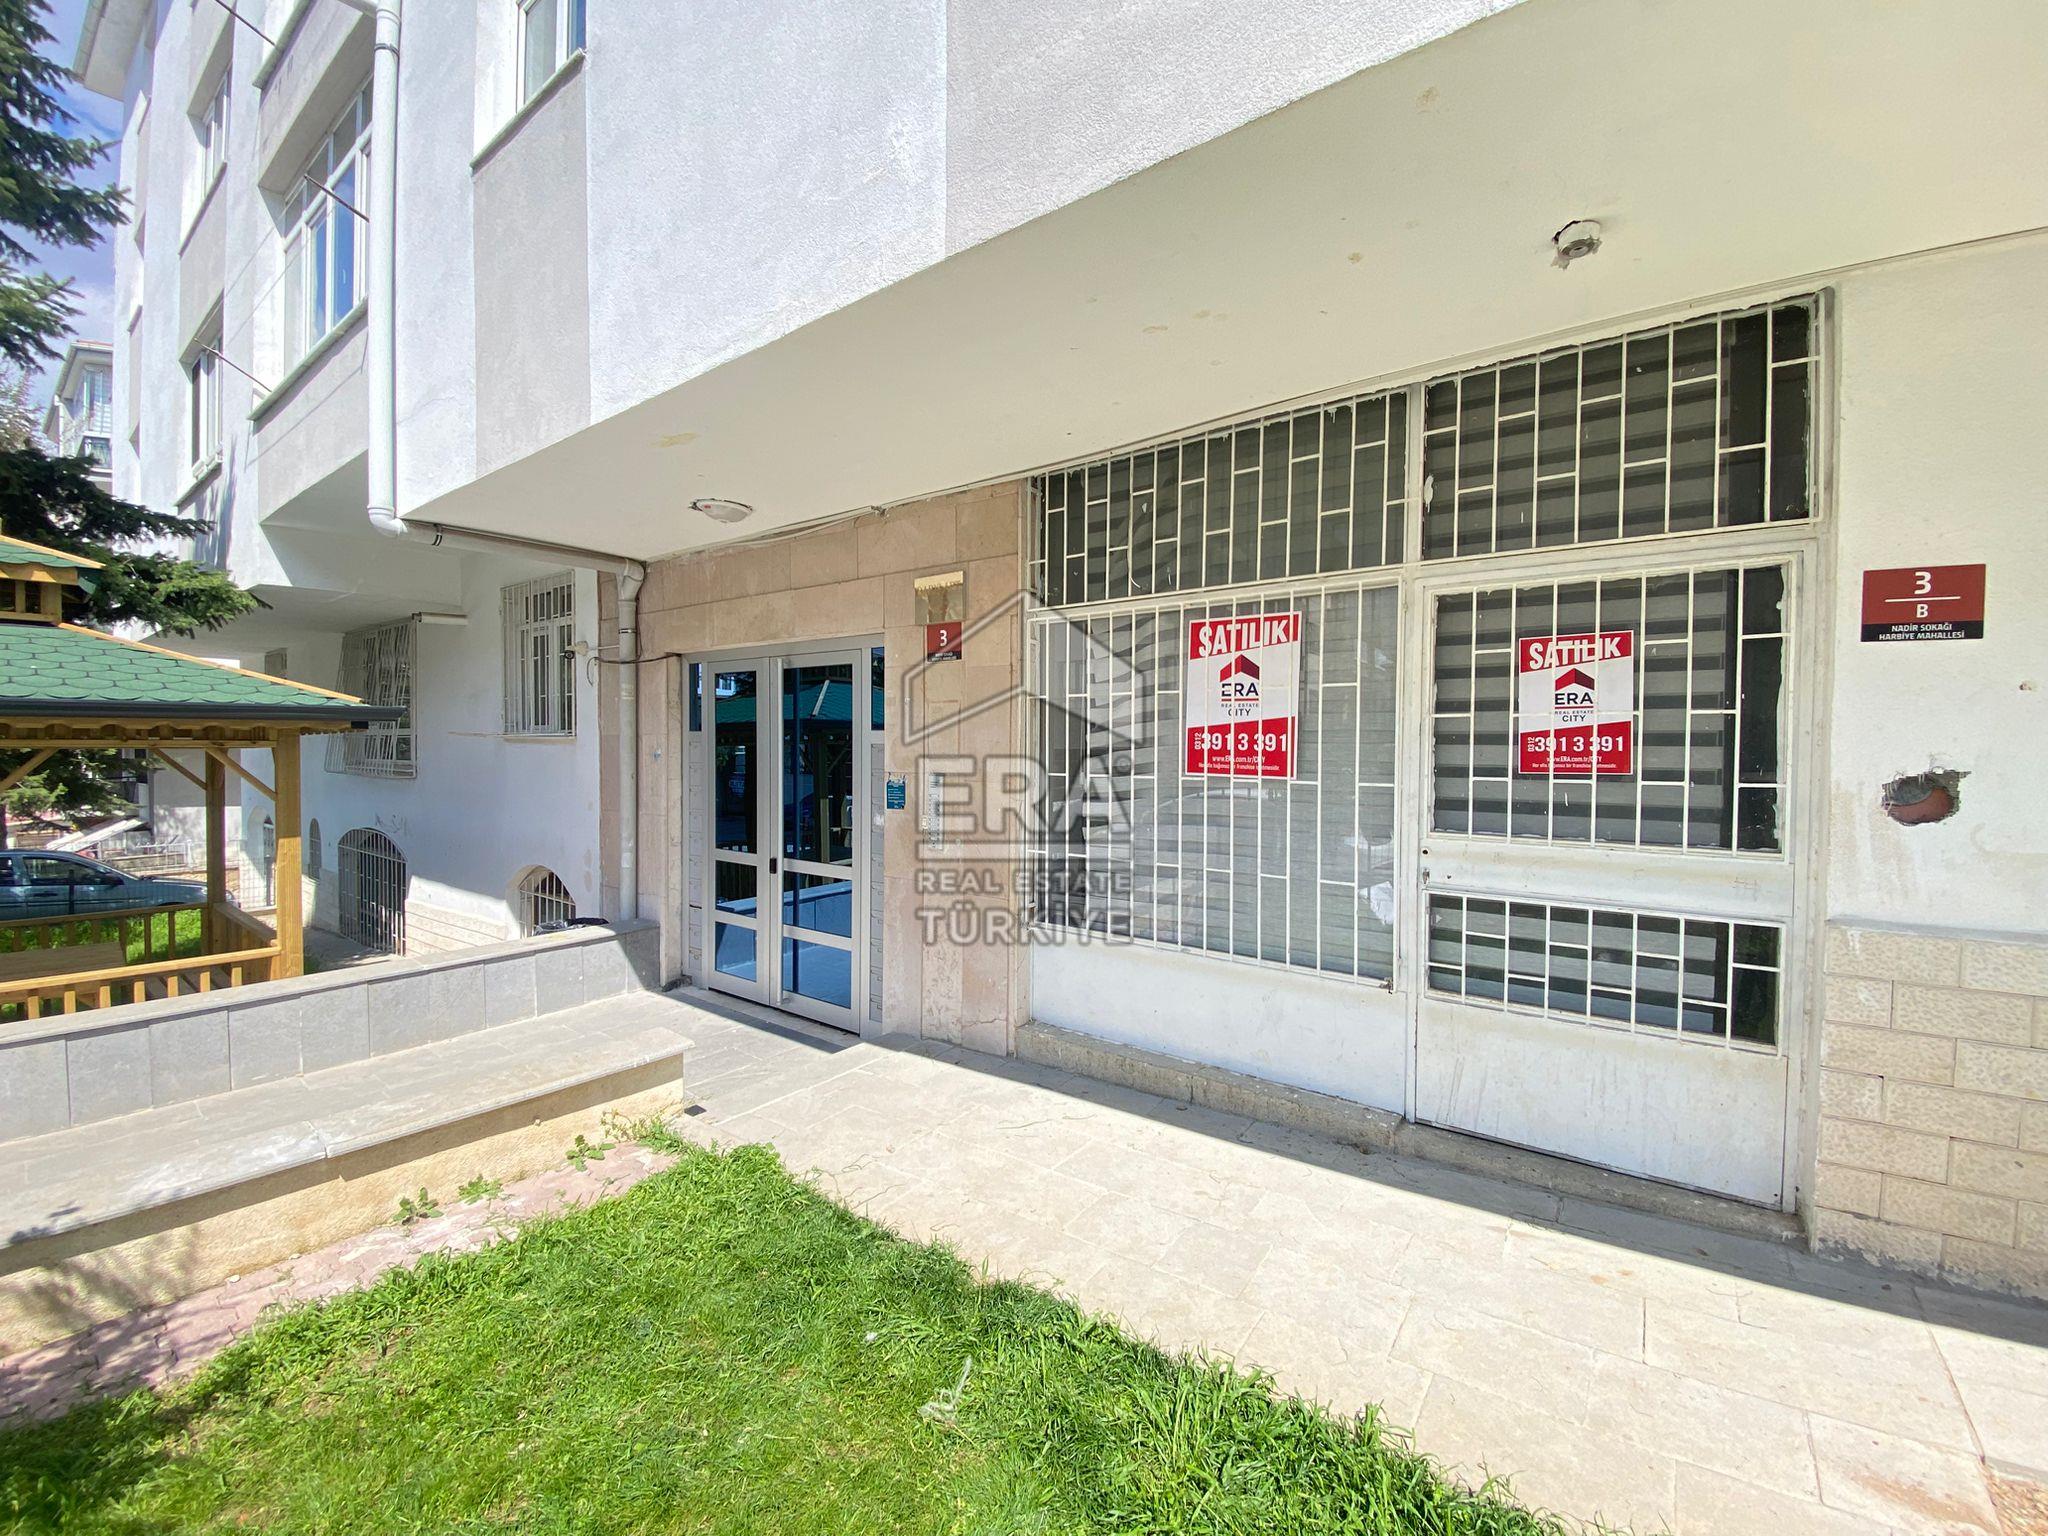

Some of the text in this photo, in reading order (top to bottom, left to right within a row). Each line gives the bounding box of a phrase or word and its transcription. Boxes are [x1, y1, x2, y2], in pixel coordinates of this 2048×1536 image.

[1914, 571, 1932, 595] 3
[1916, 604, 1929, 618] B
[1891, 622, 1952, 632] NADİR SOKAĞI
[939, 629, 948, 647] 3
[1198, 619, 1290, 658] SATILIK
[1879, 630, 1965, 641] HARBİYE MAHALLESİ
[1529, 637, 1622, 670] SATILIK
[1221, 682, 1259, 697] ERA
[1555, 692, 1594, 705] ERA
[1201, 732, 1235, 752] 391
[1237, 733, 1249, 751] 3
[1253, 733, 1287, 752] 391
[1534, 736, 1567, 752] 391
[1573, 736, 1584, 752] 3
[1589, 736, 1623, 752] 391
